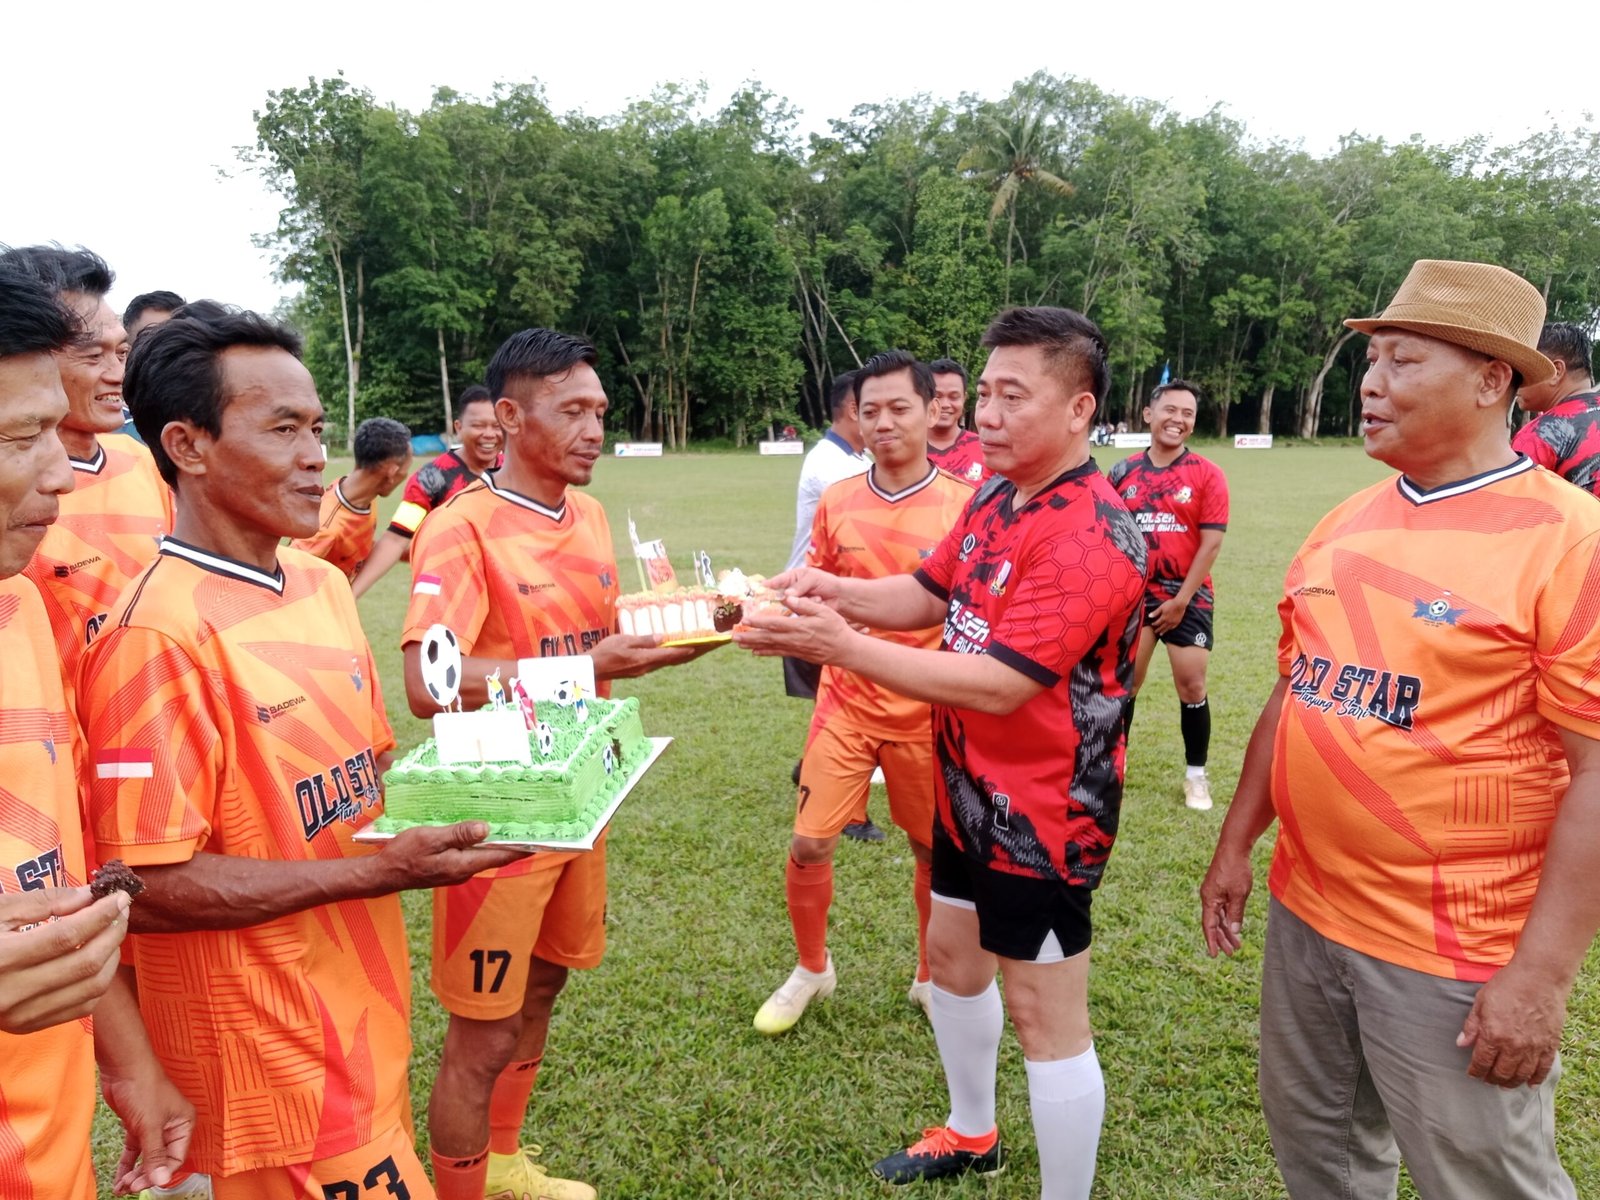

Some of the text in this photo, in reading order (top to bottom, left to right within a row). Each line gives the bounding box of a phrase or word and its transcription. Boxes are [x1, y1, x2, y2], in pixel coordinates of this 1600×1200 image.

[269, 695, 307, 714] SADEWA
[1297, 687, 1370, 721] Tanjung Sari
[1331, 664, 1422, 733] STAR
[294, 764, 353, 843] OLD
[469, 948, 512, 994] 17
